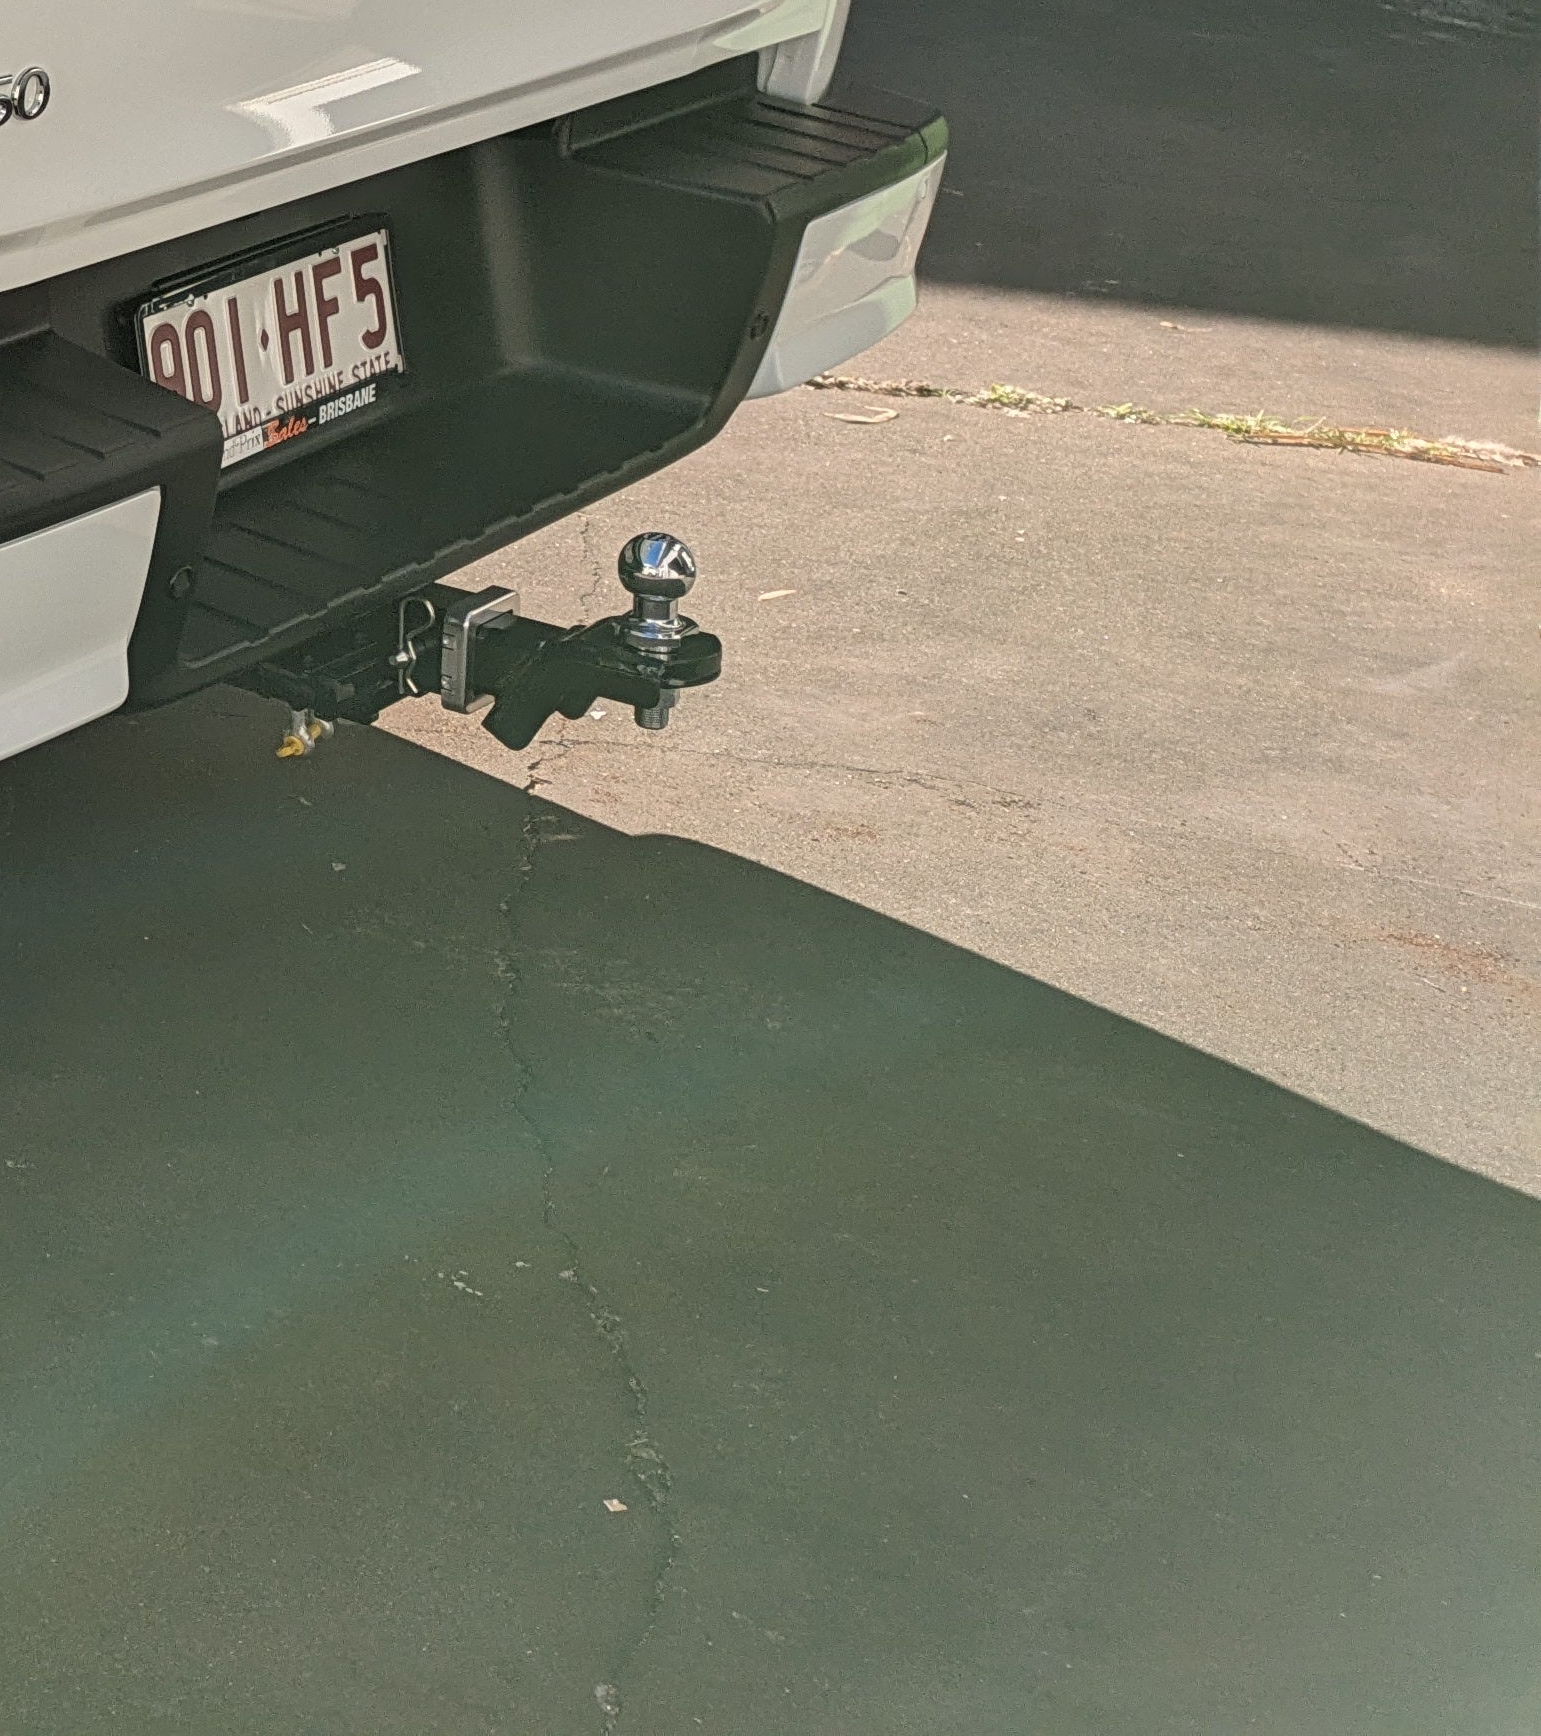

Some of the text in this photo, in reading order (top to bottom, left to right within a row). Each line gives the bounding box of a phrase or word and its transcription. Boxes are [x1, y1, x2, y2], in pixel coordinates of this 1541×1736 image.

[276, 370, 344, 414] SUNSHINE
[352, 350, 391, 382] STATE
[318, 383, 377, 426] BRISBANE
